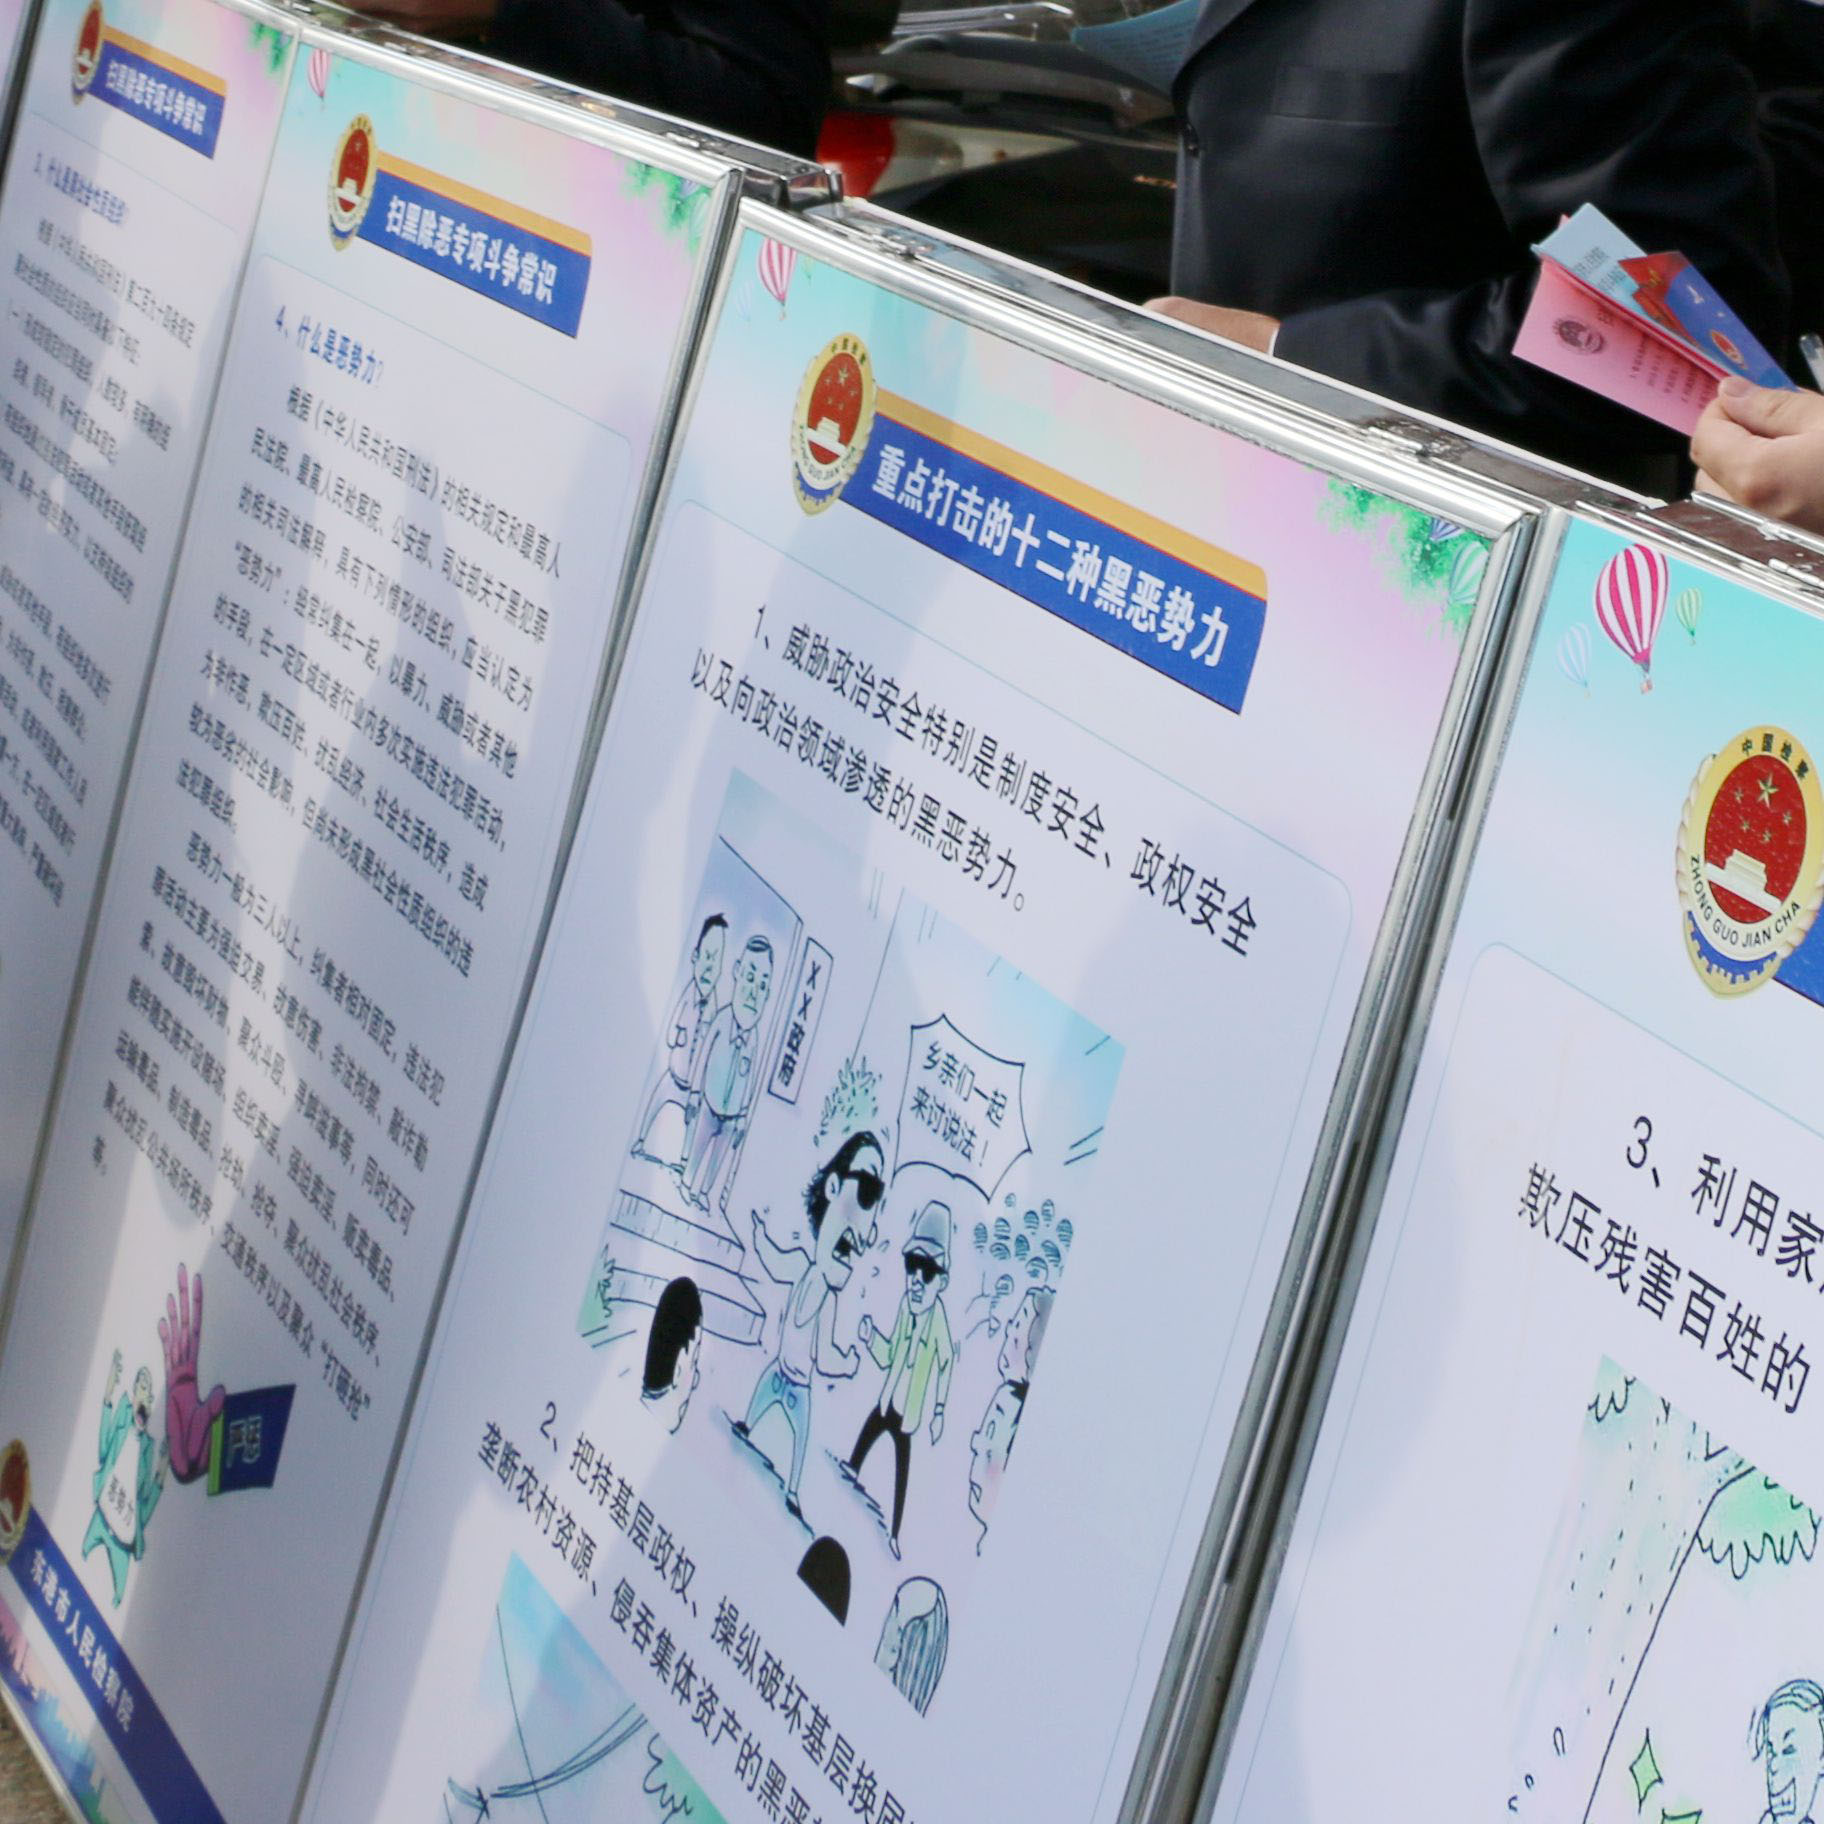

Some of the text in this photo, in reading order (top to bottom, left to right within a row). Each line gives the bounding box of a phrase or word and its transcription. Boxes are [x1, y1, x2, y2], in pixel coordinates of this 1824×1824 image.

[385, 194, 559, 306] 扫黑除恶专项斗争常识
[871, 442, 1230, 668] 重点打击的十二种黑恶势力
[690, 647, 1026, 913] 以及向政治领域渗透的黑恶势力。
[752, 603, 1260, 958] 1、威胁政治安全特别是制度安全、政权安全
[1741, 732, 1810, 781] 中国检察
[1689, 854, 1802, 949] ZHONG GUO JIAN CHA
[922, 1040, 1009, 1129] 乡亲们一起
[29, 1547, 136, 1734] 东港市人民检察院
